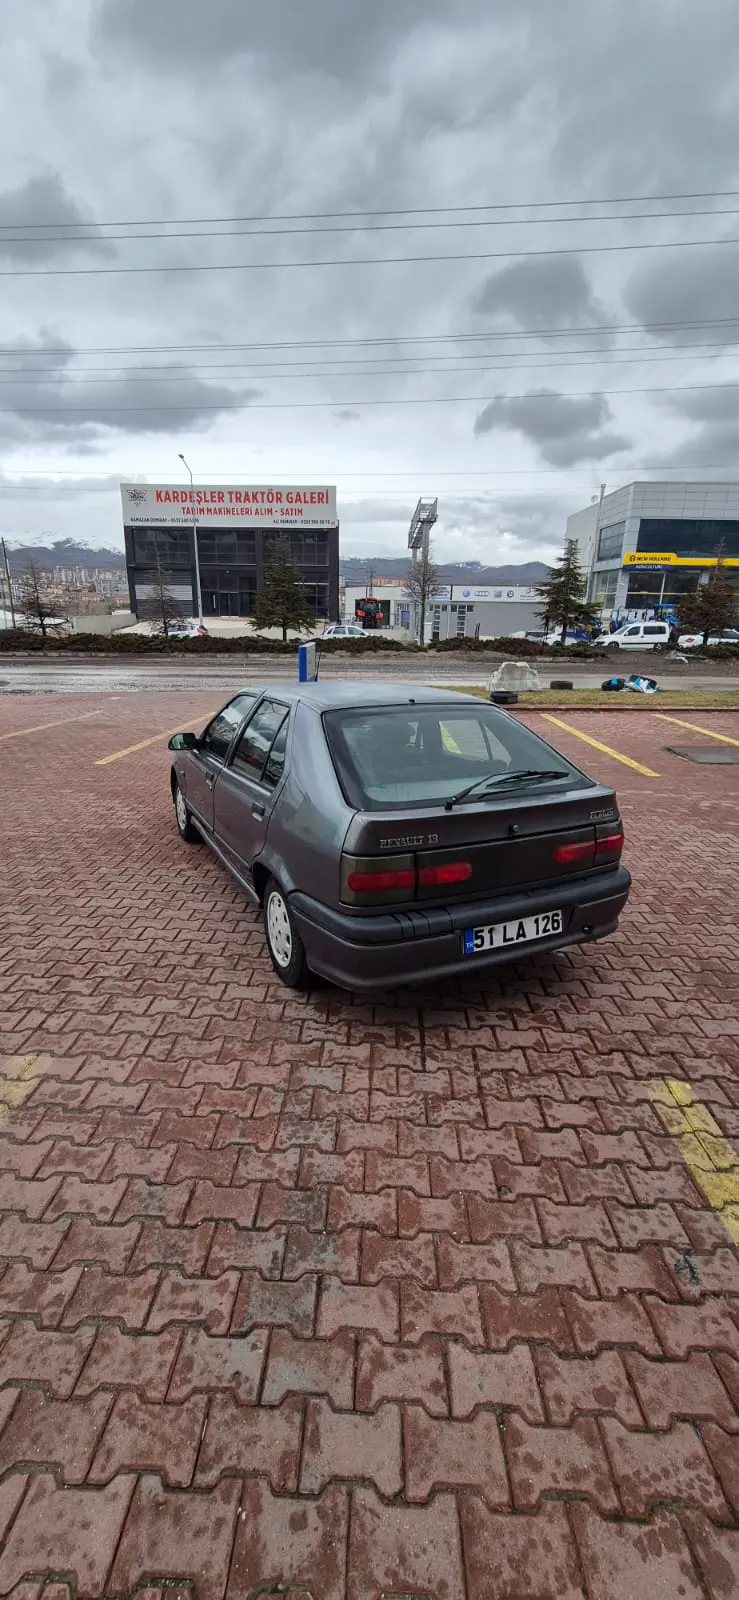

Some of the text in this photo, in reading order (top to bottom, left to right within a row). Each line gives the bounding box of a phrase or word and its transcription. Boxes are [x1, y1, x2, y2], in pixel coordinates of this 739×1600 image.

[155, 488, 330, 504] KARDEŞLER TRAKTÖR GALERİ
[206, 506, 253, 516] MAKİNELERİ
[254, 507, 273, 516] ALIM
[280, 507, 304, 517] SATIM
[379, 835, 425, 849] RENAULT
[474, 912, 561, 949] 51 LA 126
